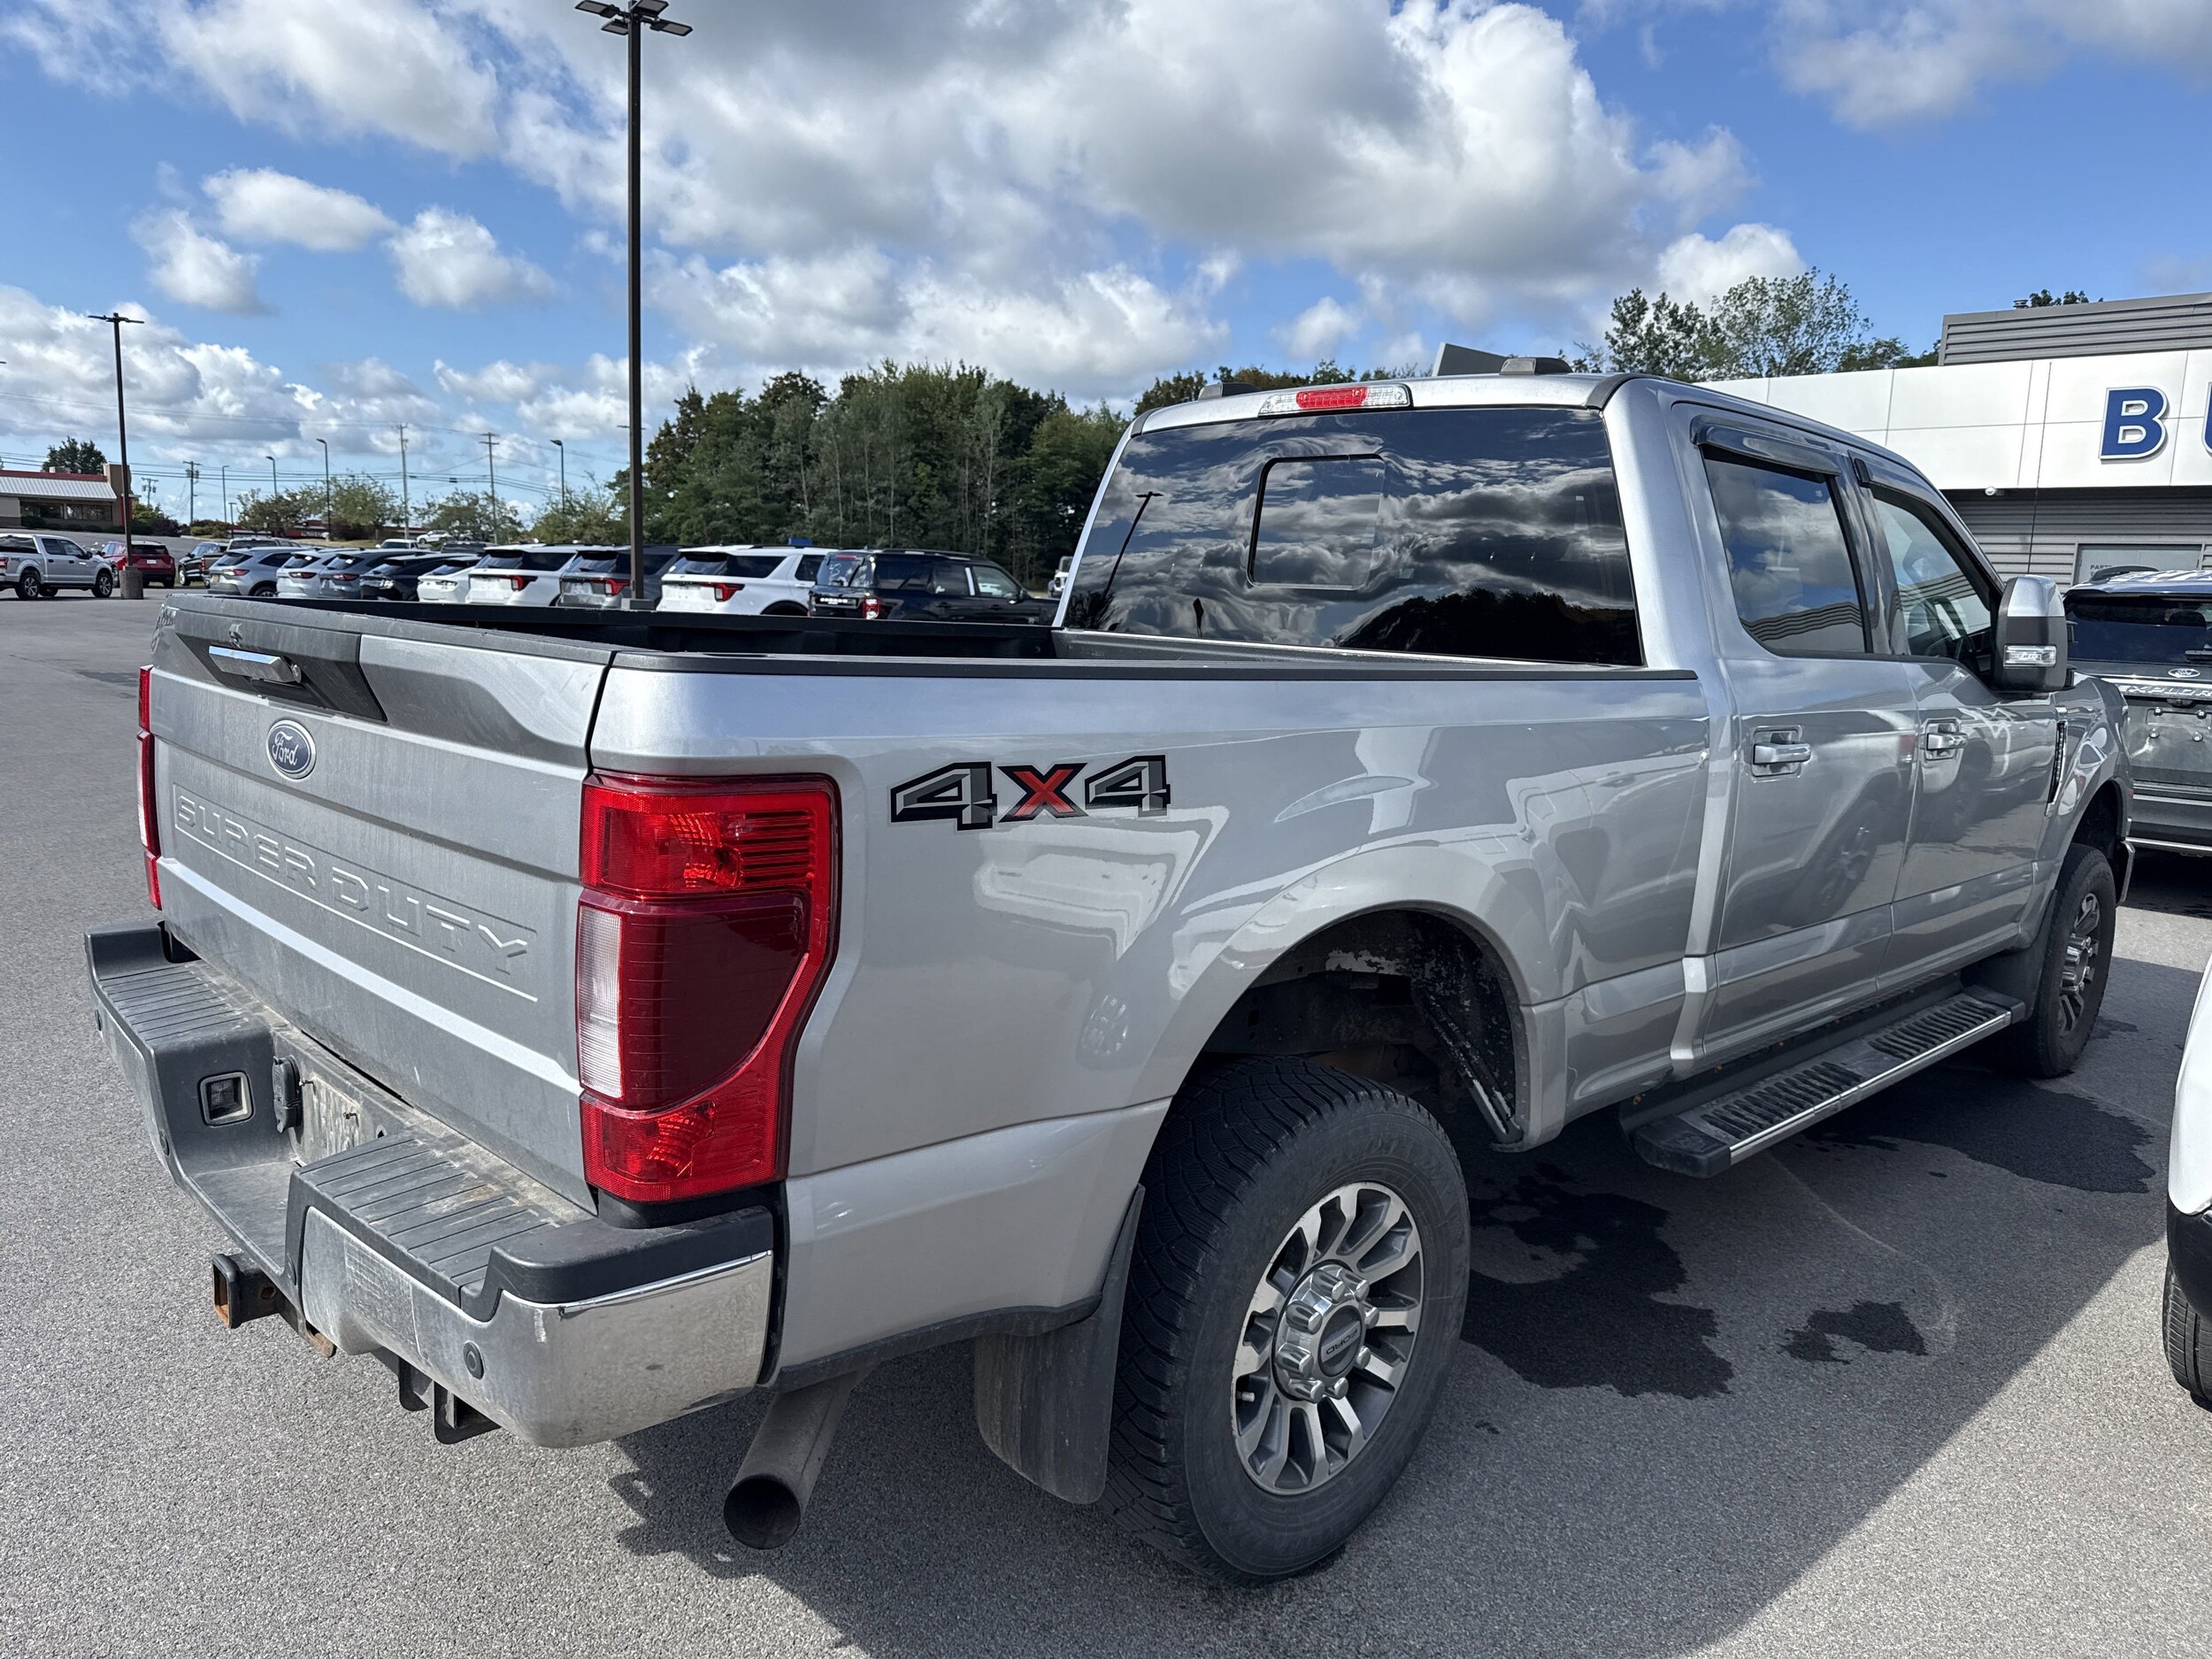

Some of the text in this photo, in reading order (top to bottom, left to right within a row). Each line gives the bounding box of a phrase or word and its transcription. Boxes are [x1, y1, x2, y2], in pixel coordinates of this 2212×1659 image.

[272, 731, 299, 766] Ford
[178, 795, 528, 975] SUPER DUTY
[1325, 1328, 1358, 1356] FORD
